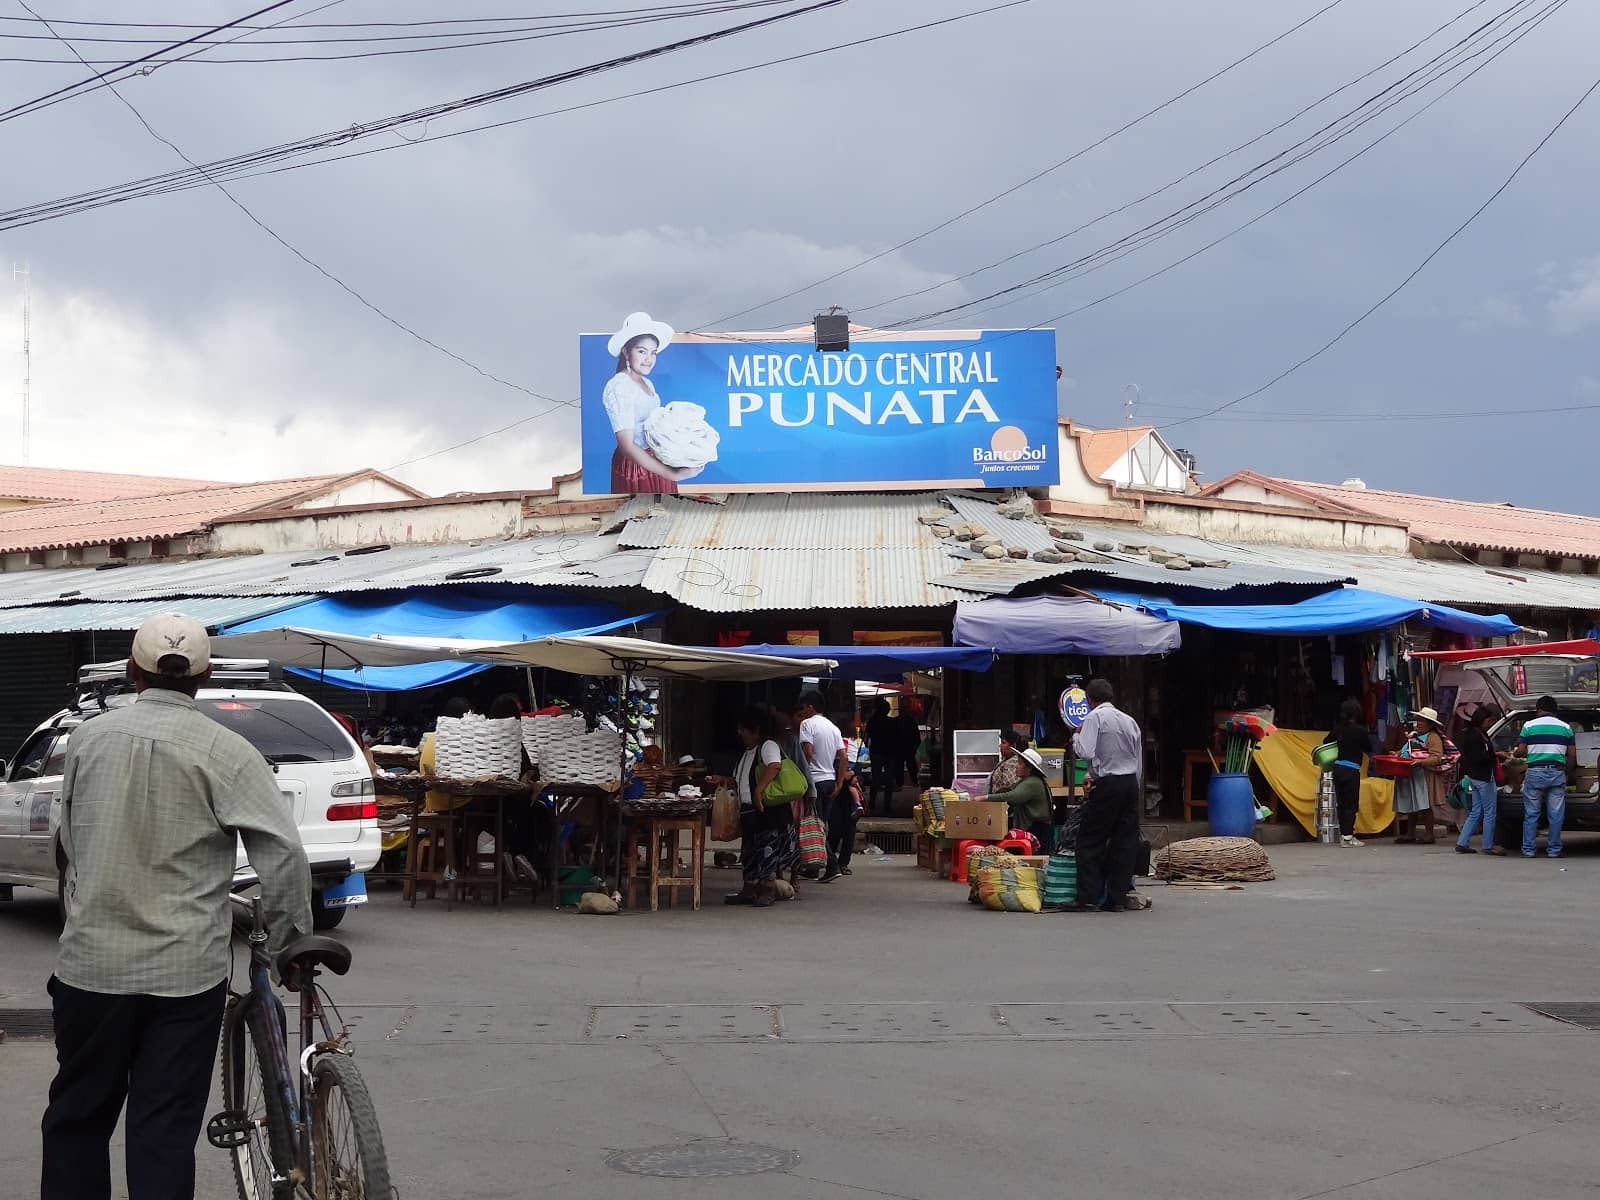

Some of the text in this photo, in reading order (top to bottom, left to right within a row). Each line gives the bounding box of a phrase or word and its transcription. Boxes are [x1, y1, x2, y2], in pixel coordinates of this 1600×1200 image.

[727, 351, 999, 387] MERCADO CENTRAL
[728, 388, 1001, 427] PUNATA
[973, 444, 1047, 462] BancoSol
[1006, 464, 1040, 472] crecemos
